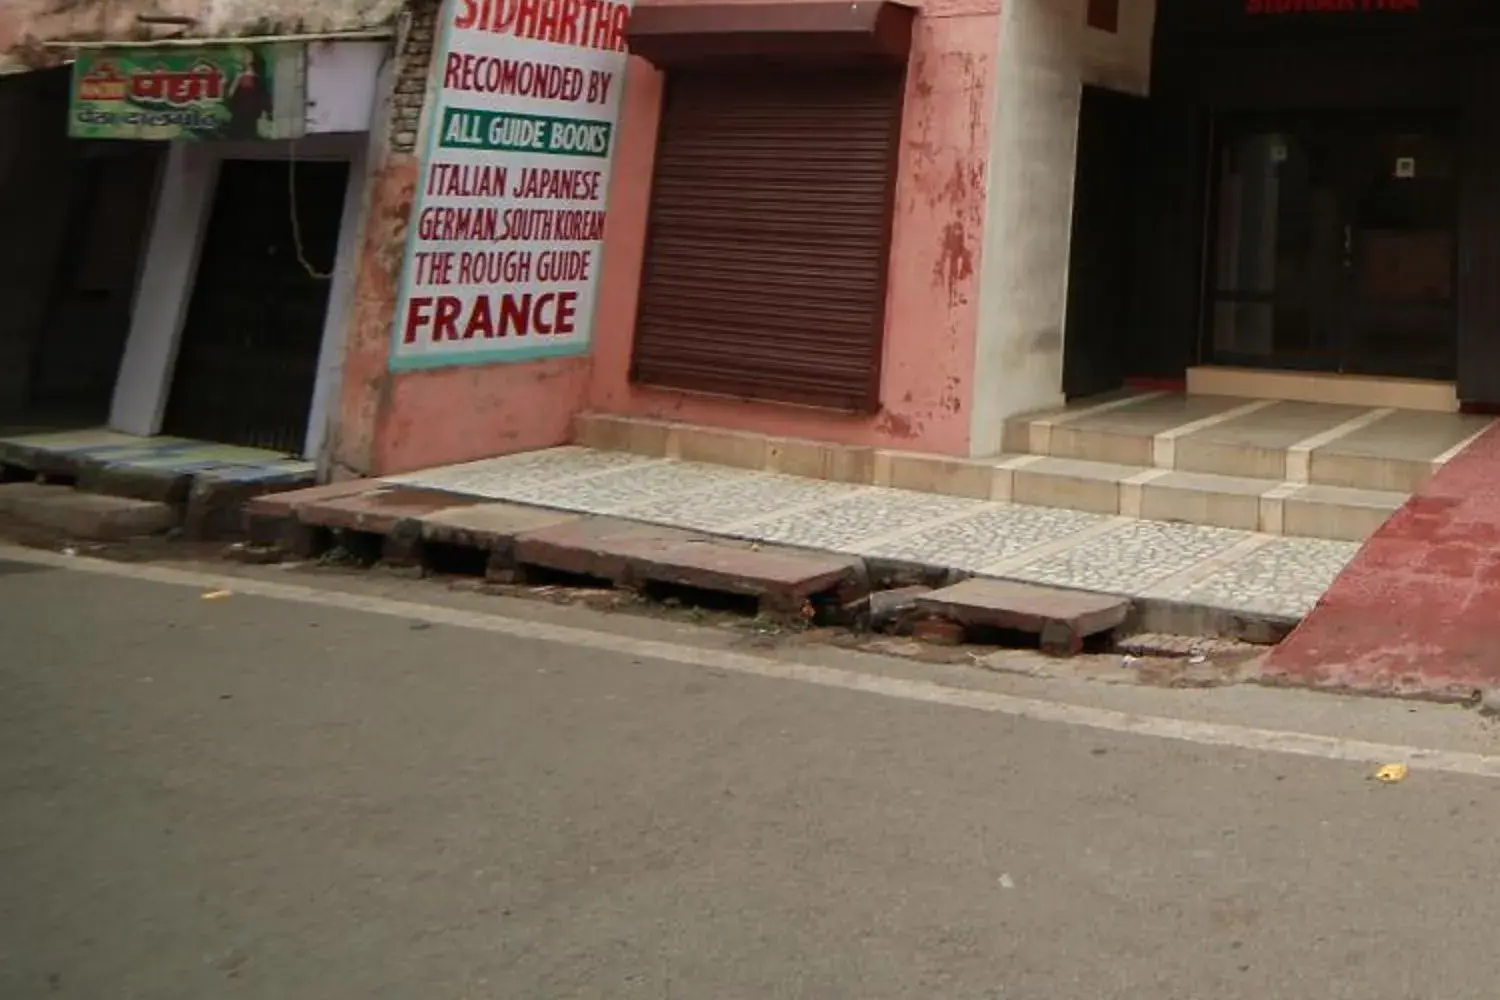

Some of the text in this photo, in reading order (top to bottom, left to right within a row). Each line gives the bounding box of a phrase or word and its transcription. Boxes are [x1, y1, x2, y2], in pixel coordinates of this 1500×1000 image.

[443, 51, 612, 105] RECOMONDED BY
[446, 112, 608, 153] ALL GUIDE BOOKS
[426, 163, 602, 200] ITALIAN JAPANESE
[554, 209, 607, 242] KOREAN
[415, 250, 591, 286] THE ROUGH GUIDE
[403, 292, 579, 344] FRANCE
